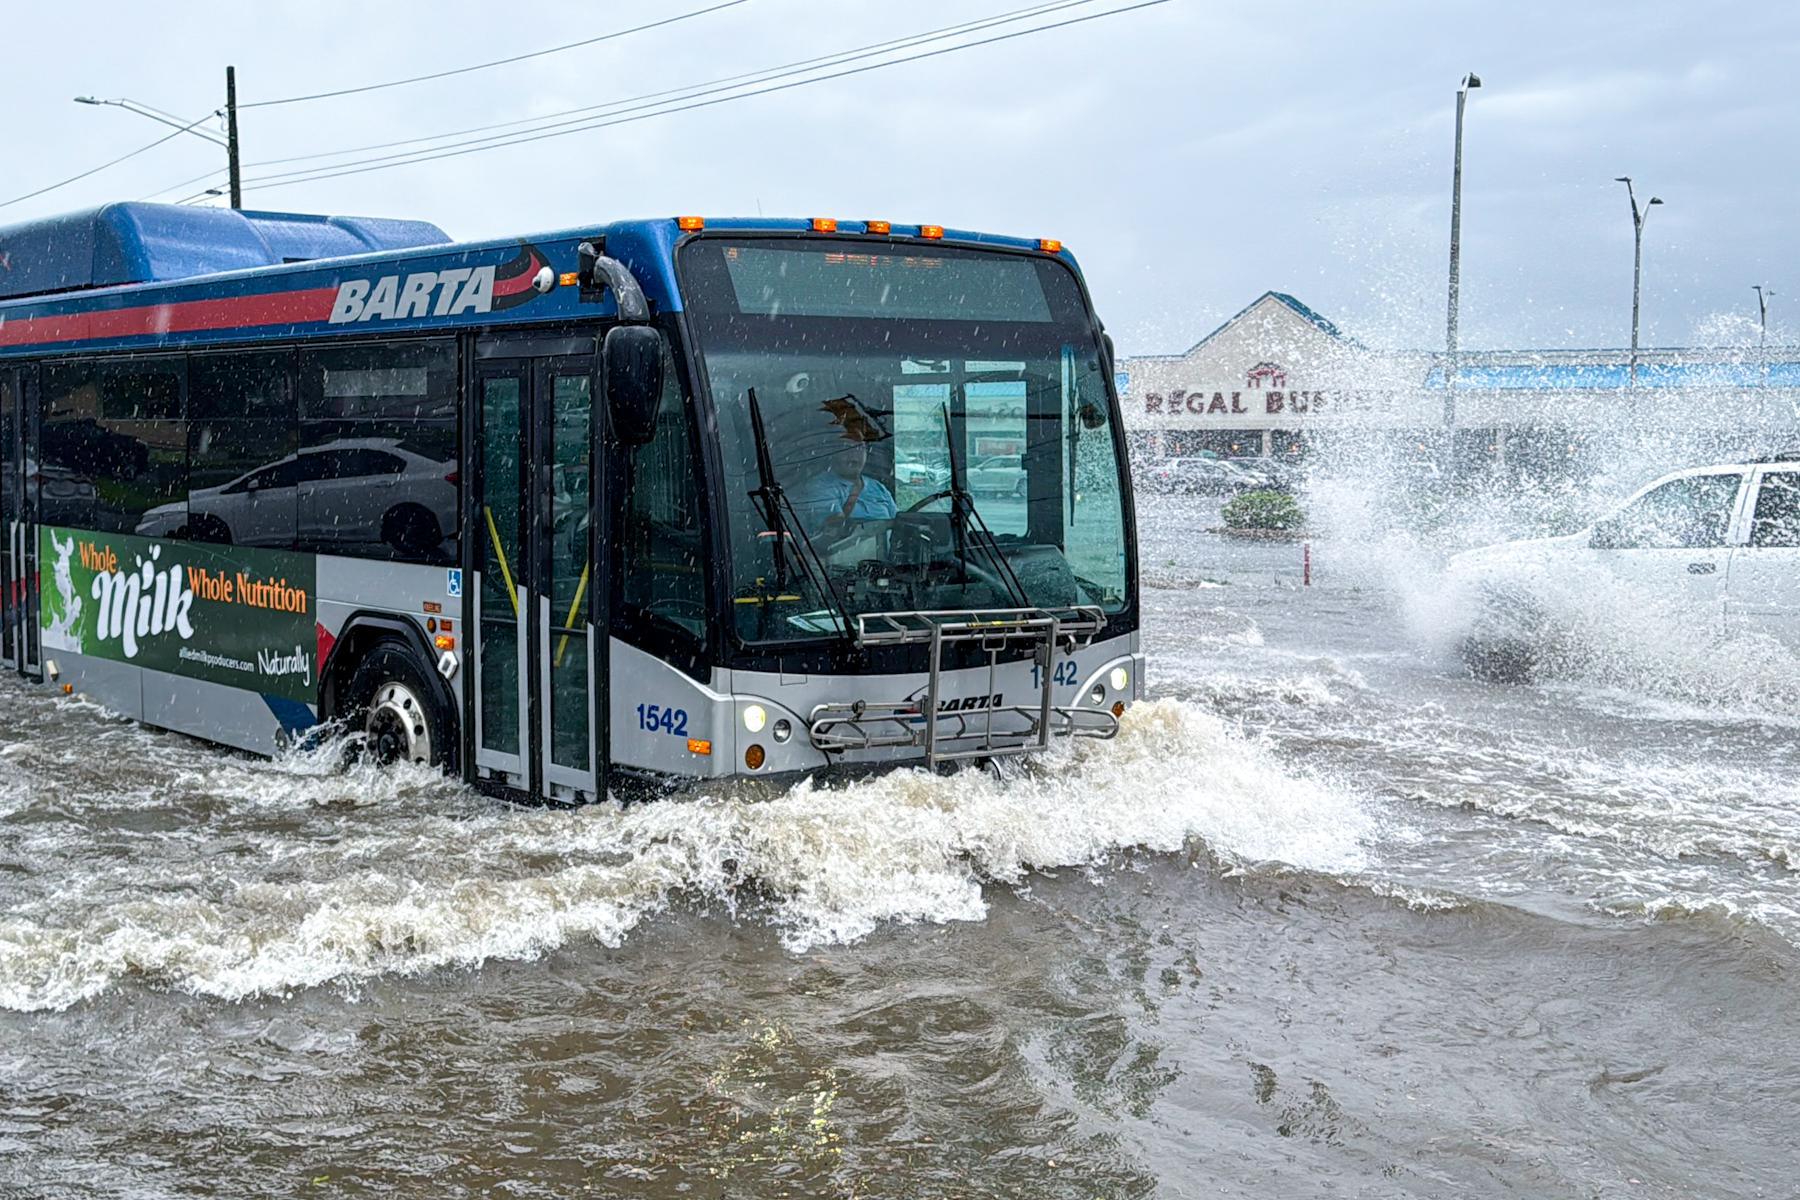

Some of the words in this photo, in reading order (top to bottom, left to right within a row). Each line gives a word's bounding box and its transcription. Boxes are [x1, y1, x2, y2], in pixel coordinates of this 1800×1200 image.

[329, 265, 496, 324] BARTA
[1145, 391, 1248, 415] REGAL
[79, 541, 117, 573] Whole
[187, 567, 233, 602] Whole
[236, 573, 307, 613] Nutrition
[257, 646, 310, 687] Naturally
[1031, 661, 1077, 688] 142
[637, 703, 688, 737] 1542
